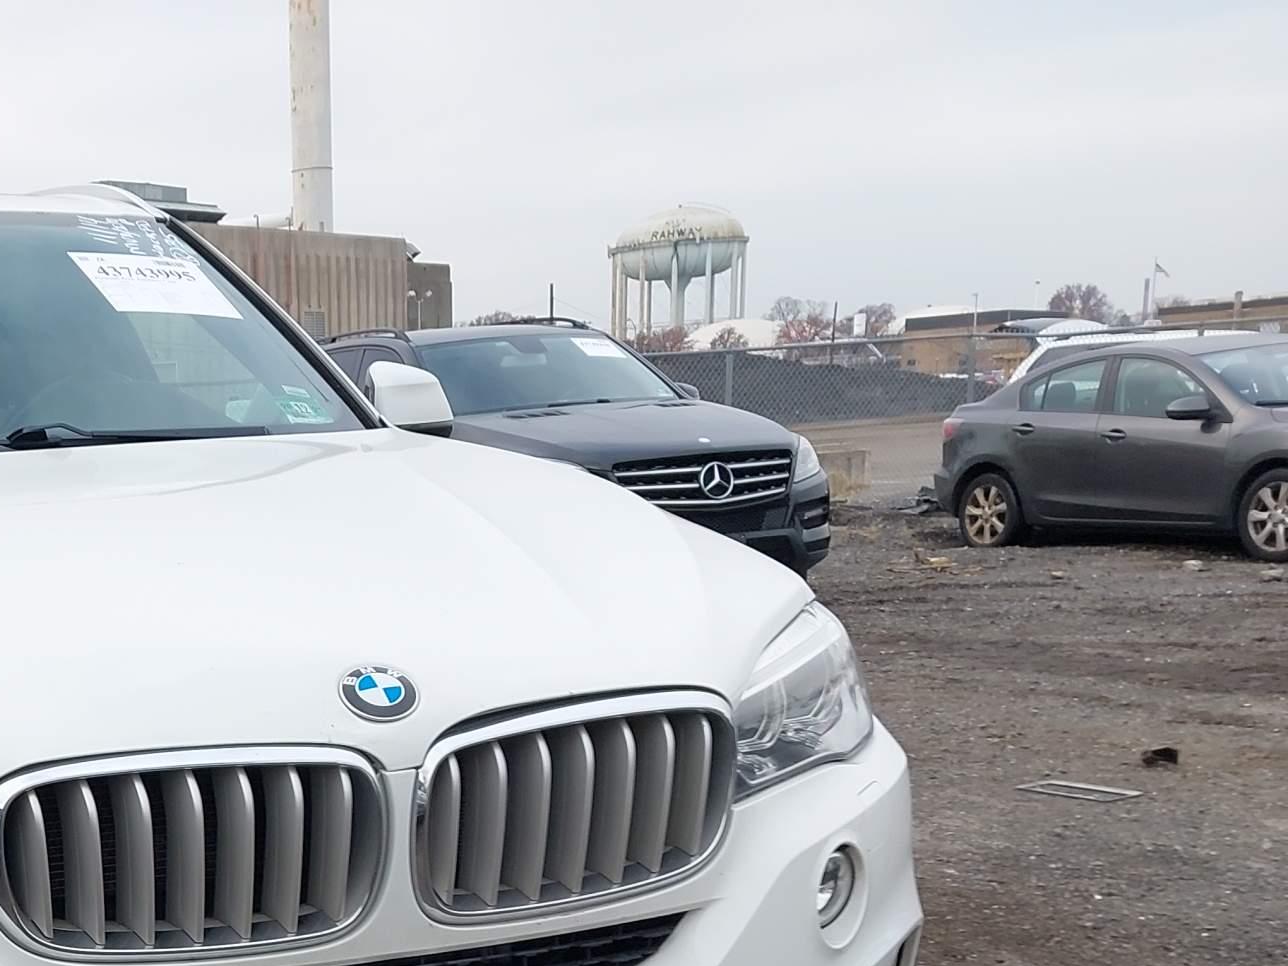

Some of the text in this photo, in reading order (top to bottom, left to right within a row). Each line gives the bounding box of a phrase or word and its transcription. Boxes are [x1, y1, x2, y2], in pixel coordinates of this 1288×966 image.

[651, 226, 703, 241] RAHWAY
[96, 265, 197, 282] 43743995
[342, 665, 402, 686] BMW
